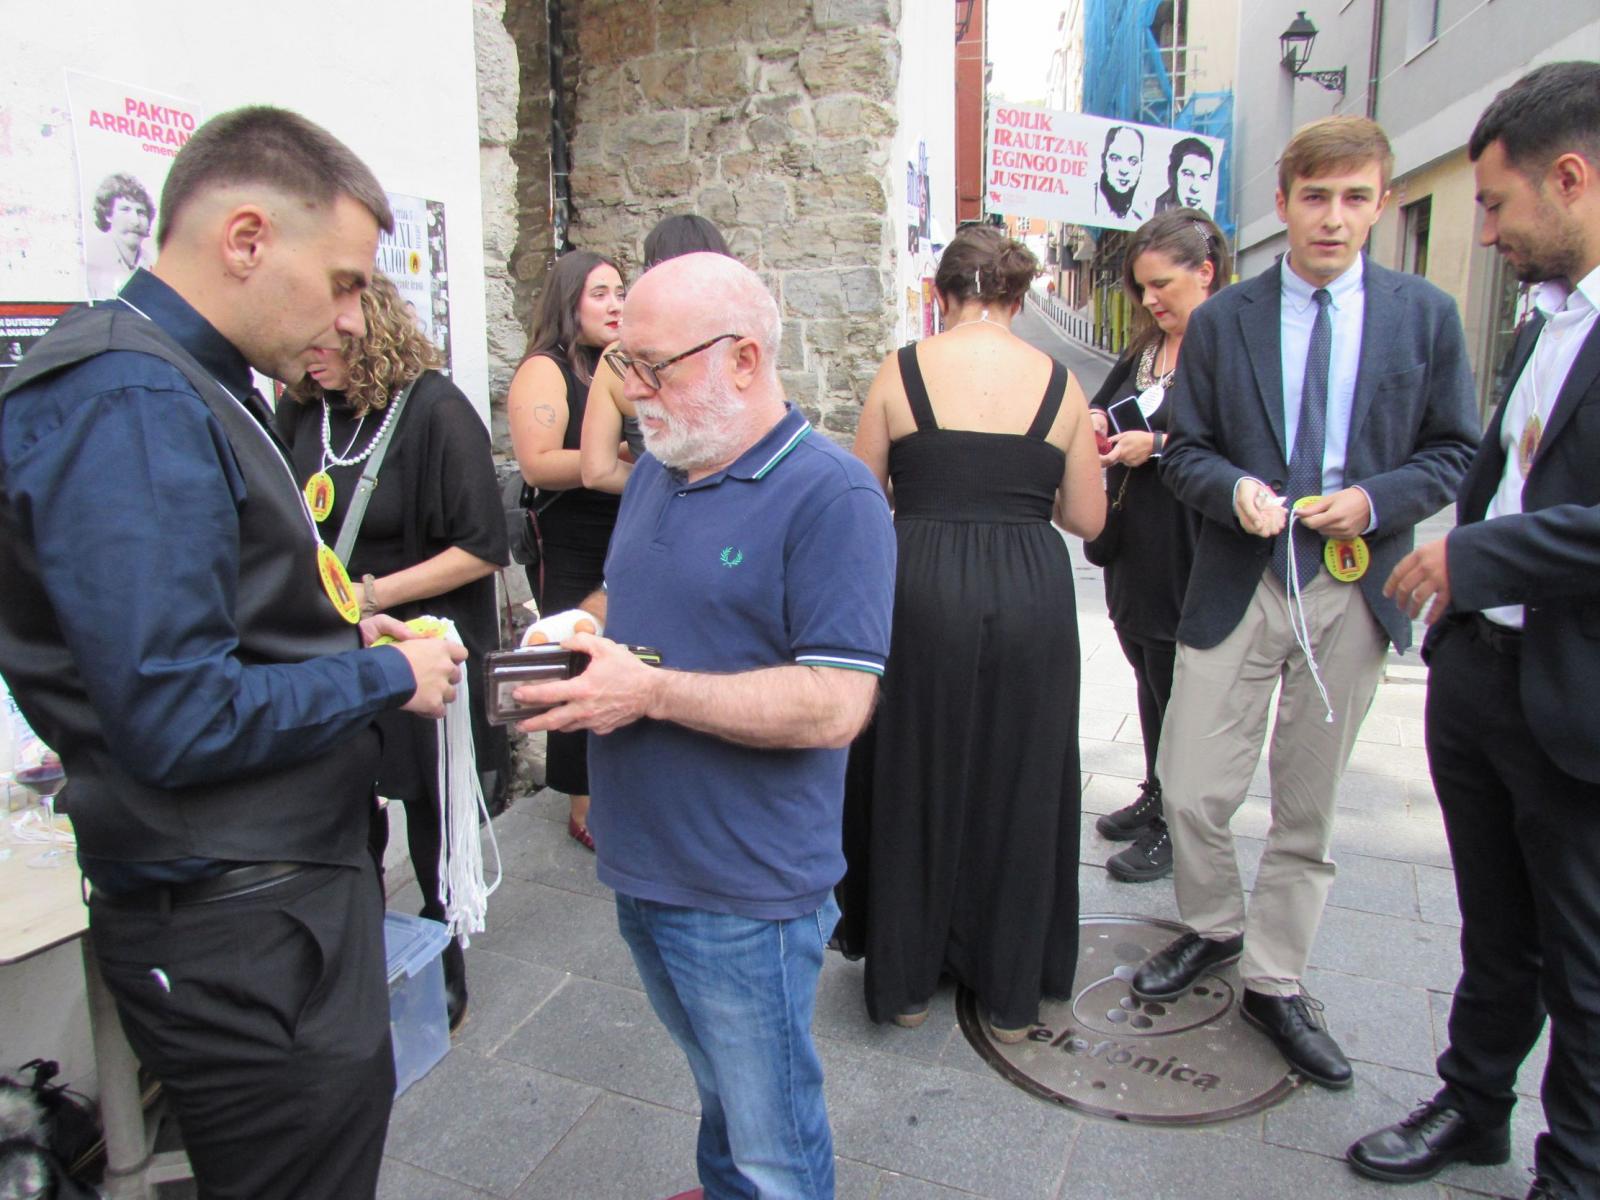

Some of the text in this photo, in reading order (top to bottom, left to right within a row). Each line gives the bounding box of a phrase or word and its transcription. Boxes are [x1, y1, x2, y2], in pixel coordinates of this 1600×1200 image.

[125, 97, 195, 131] PAKITO
[996, 108, 1053, 131] SOILIK
[994, 128, 1088, 157] IRAULTZAK
[992, 149, 1088, 177] EGINGO DIE
[990, 170, 1069, 195] JUSTIZIA.
